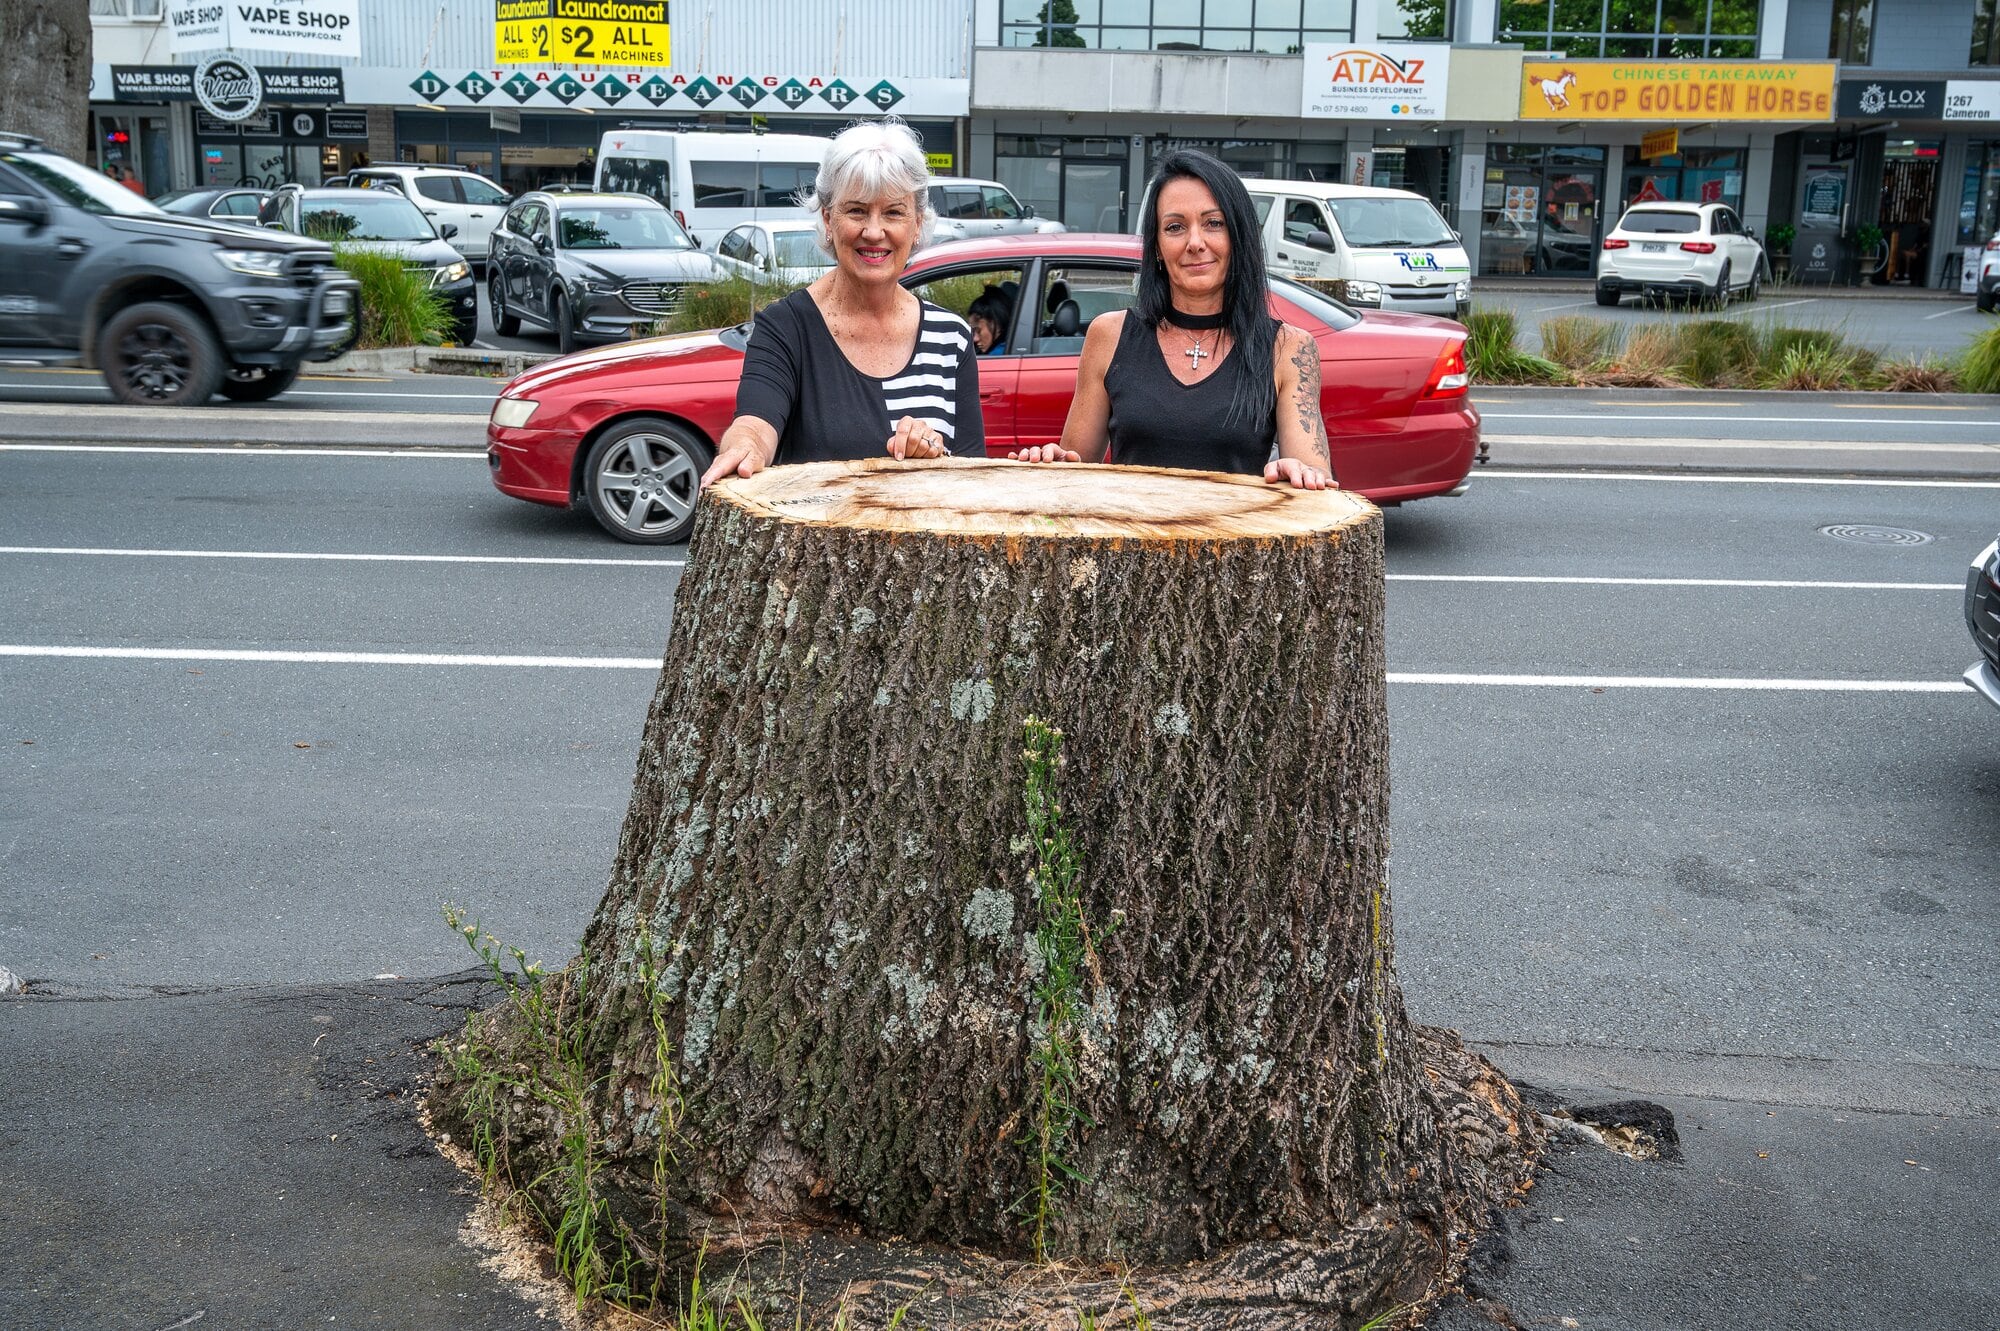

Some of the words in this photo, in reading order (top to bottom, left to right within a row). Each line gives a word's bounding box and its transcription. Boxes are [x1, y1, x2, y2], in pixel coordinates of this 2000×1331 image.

[172, 9, 196, 27] VAPE
[198, 5, 223, 24] SHOP
[496, 0, 549, 20] Laundromat
[557, 0, 665, 22] Laundromat
[238, 5, 291, 25] VAPE
[297, 11, 351, 30] SHOP
[249, 26, 342, 41] WWW.EASYPUFF.CO.NZ
[503, 25, 524, 44] ALL
[532, 24, 549, 57] $2
[561, 25, 595, 59] $2
[612, 26, 653, 47] ALL
[498, 49, 529, 59] MACHINES
[602, 50, 664, 62] MACHINES
[116, 73, 152, 85] VAPE
[154, 73, 191, 86] SHOP
[1612, 68, 1691, 81] CHINESE
[1701, 68, 1797, 81] TAKEAWAY
[264, 75, 300, 87] VAPE
[302, 75, 338, 88] SHOP
[1332, 85, 1368, 94] BUSINESS
[1370, 86, 1423, 95] DEVELOPMENT
[1888, 89, 1926, 104] LOX
[1580, 88, 1627, 113] TOP
[1638, 83, 1735, 113] GOLDEN
[1746, 85, 1829, 113] HORSE
[1946, 95, 1973, 107] 1267
[1312, 104, 1321, 112] Ph
[1335, 105, 1348, 113] 579
[1350, 105, 1368, 113] 4800
[1944, 108, 1990, 118] Cameron
[297, 119, 310, 130] R18
